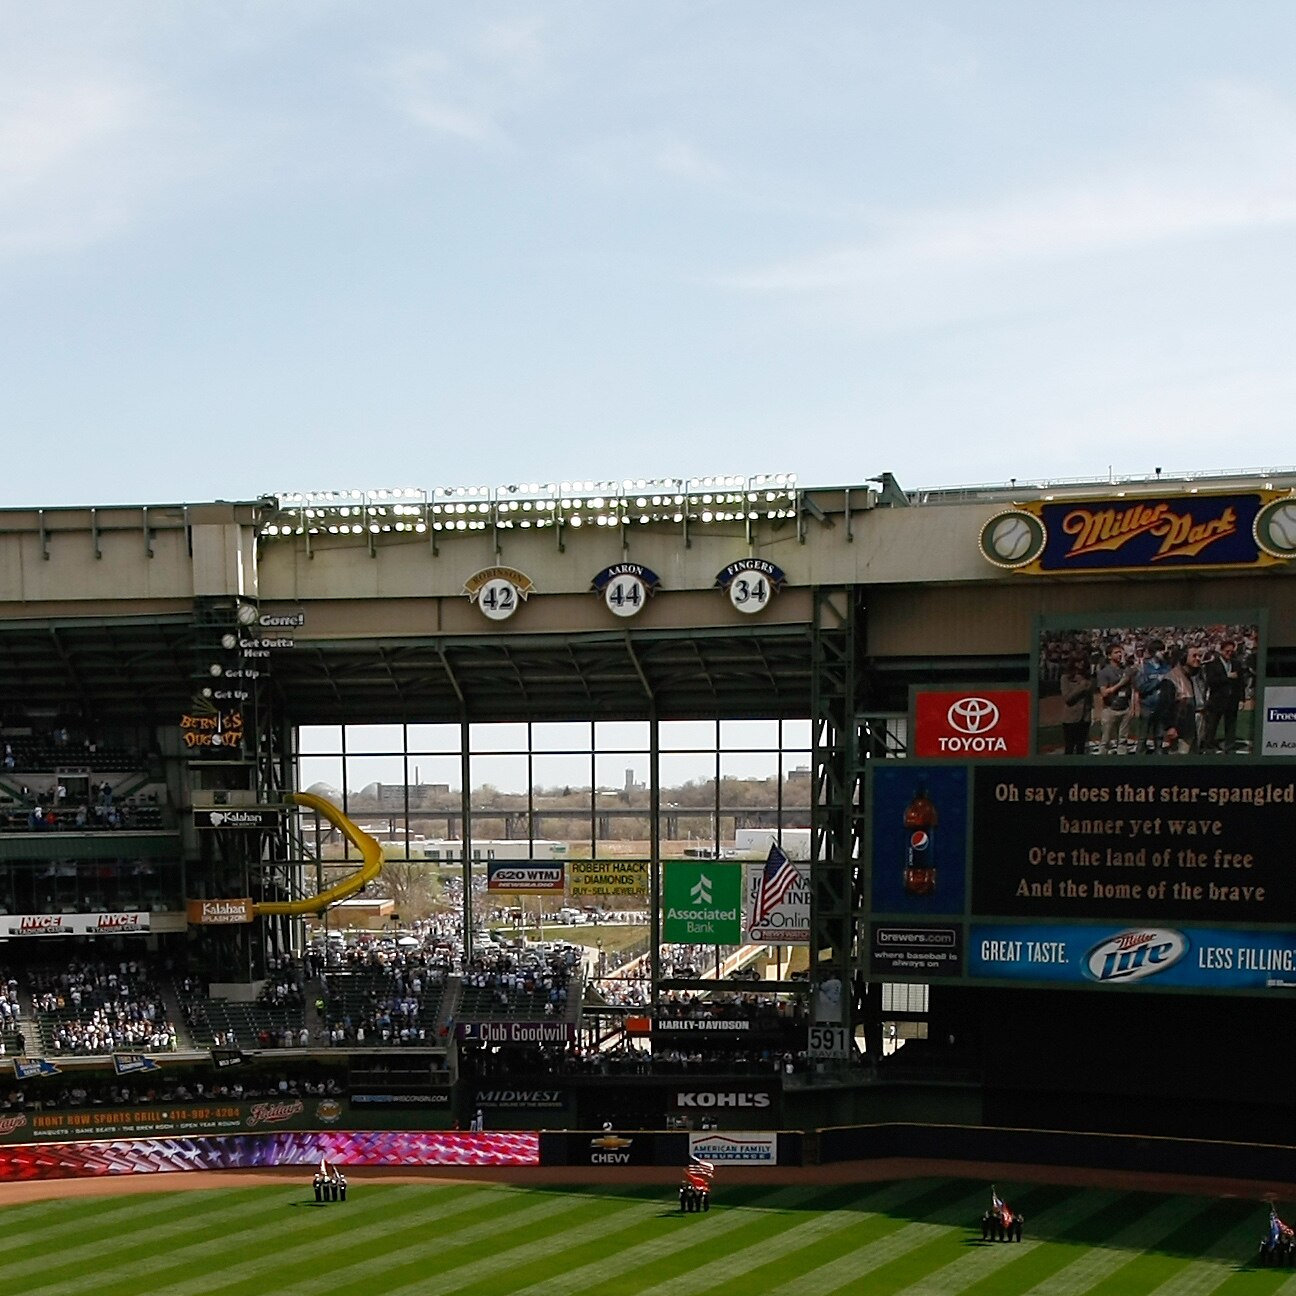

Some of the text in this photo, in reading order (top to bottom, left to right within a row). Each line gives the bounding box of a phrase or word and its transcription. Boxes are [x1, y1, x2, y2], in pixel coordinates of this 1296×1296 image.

[1063, 502, 1238, 561] Miller Park
[607, 564, 643, 577] AARON
[727, 560, 774, 576] FINGERS
[609, 584, 642, 607] 44
[735, 580, 768, 603] 34
[482, 587, 515, 611] 42
[259, 614, 304, 627] Gone!
[239, 638, 294, 648] Get Outta
[244, 648, 270, 658] Here
[225, 669, 260, 680] Get Up
[214, 690, 249, 700] Get Up
[938, 737, 1008, 752] TOYOTA
[994, 783, 1296, 807] Oh say, does that star-spangled
[223, 811, 263, 823] Kalahari
[1059, 815, 1223, 838] banner yet wave
[1028, 847, 1254, 869] O'er the land of the free
[496, 869, 560, 880] 620 WTMJ
[572, 862, 646, 873] ROBERT HAACK
[584, 874, 634, 885] DIAMONDS
[1015, 878, 1266, 902] And the home of the brave
[202, 902, 246, 916] Kalahari
[667, 908, 737, 921] Associated
[20, 916, 62, 930] NYCE
[97, 914, 140, 928] NYCE
[687, 921, 715, 933] Bank
[880, 931, 952, 943] brewers.com
[874, 951, 947, 961] where baseball
[981, 941, 1070, 966] GREAT TASTE.
[1092, 932, 1174, 982] Miller Lite
[1198, 946, 1234, 970] LESS
[479, 1023, 568, 1041] Club Goodwill
[658, 1020, 750, 1031] HARLEY-DAVIDSON
[810, 1029, 845, 1050] 591
[475, 1090, 563, 1102] MIDWEST
[676, 1092, 771, 1108] KOHL'S
[32, 1108, 161, 1127] FRONT ROW SPORTS GRILL
[246, 1097, 304, 1127] Friday's
[694, 1145, 771, 1153] AMERICAN FAMILY
[590, 1153, 630, 1164] CHEVY
